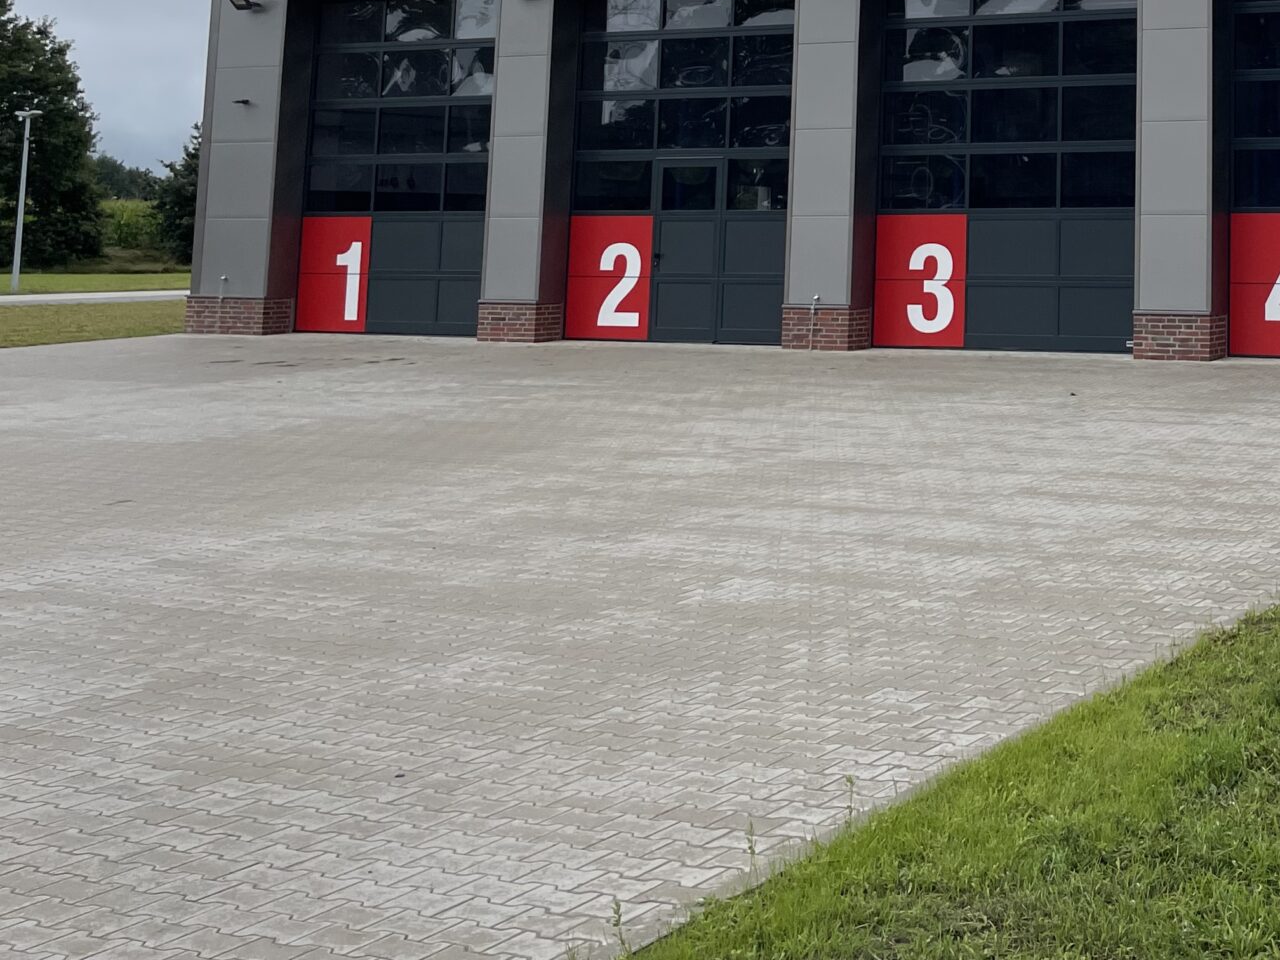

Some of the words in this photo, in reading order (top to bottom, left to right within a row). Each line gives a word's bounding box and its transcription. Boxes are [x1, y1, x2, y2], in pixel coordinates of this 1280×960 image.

[335, 241, 362, 322] 1
[597, 242, 641, 328] 2
[906, 243, 955, 334] 3
